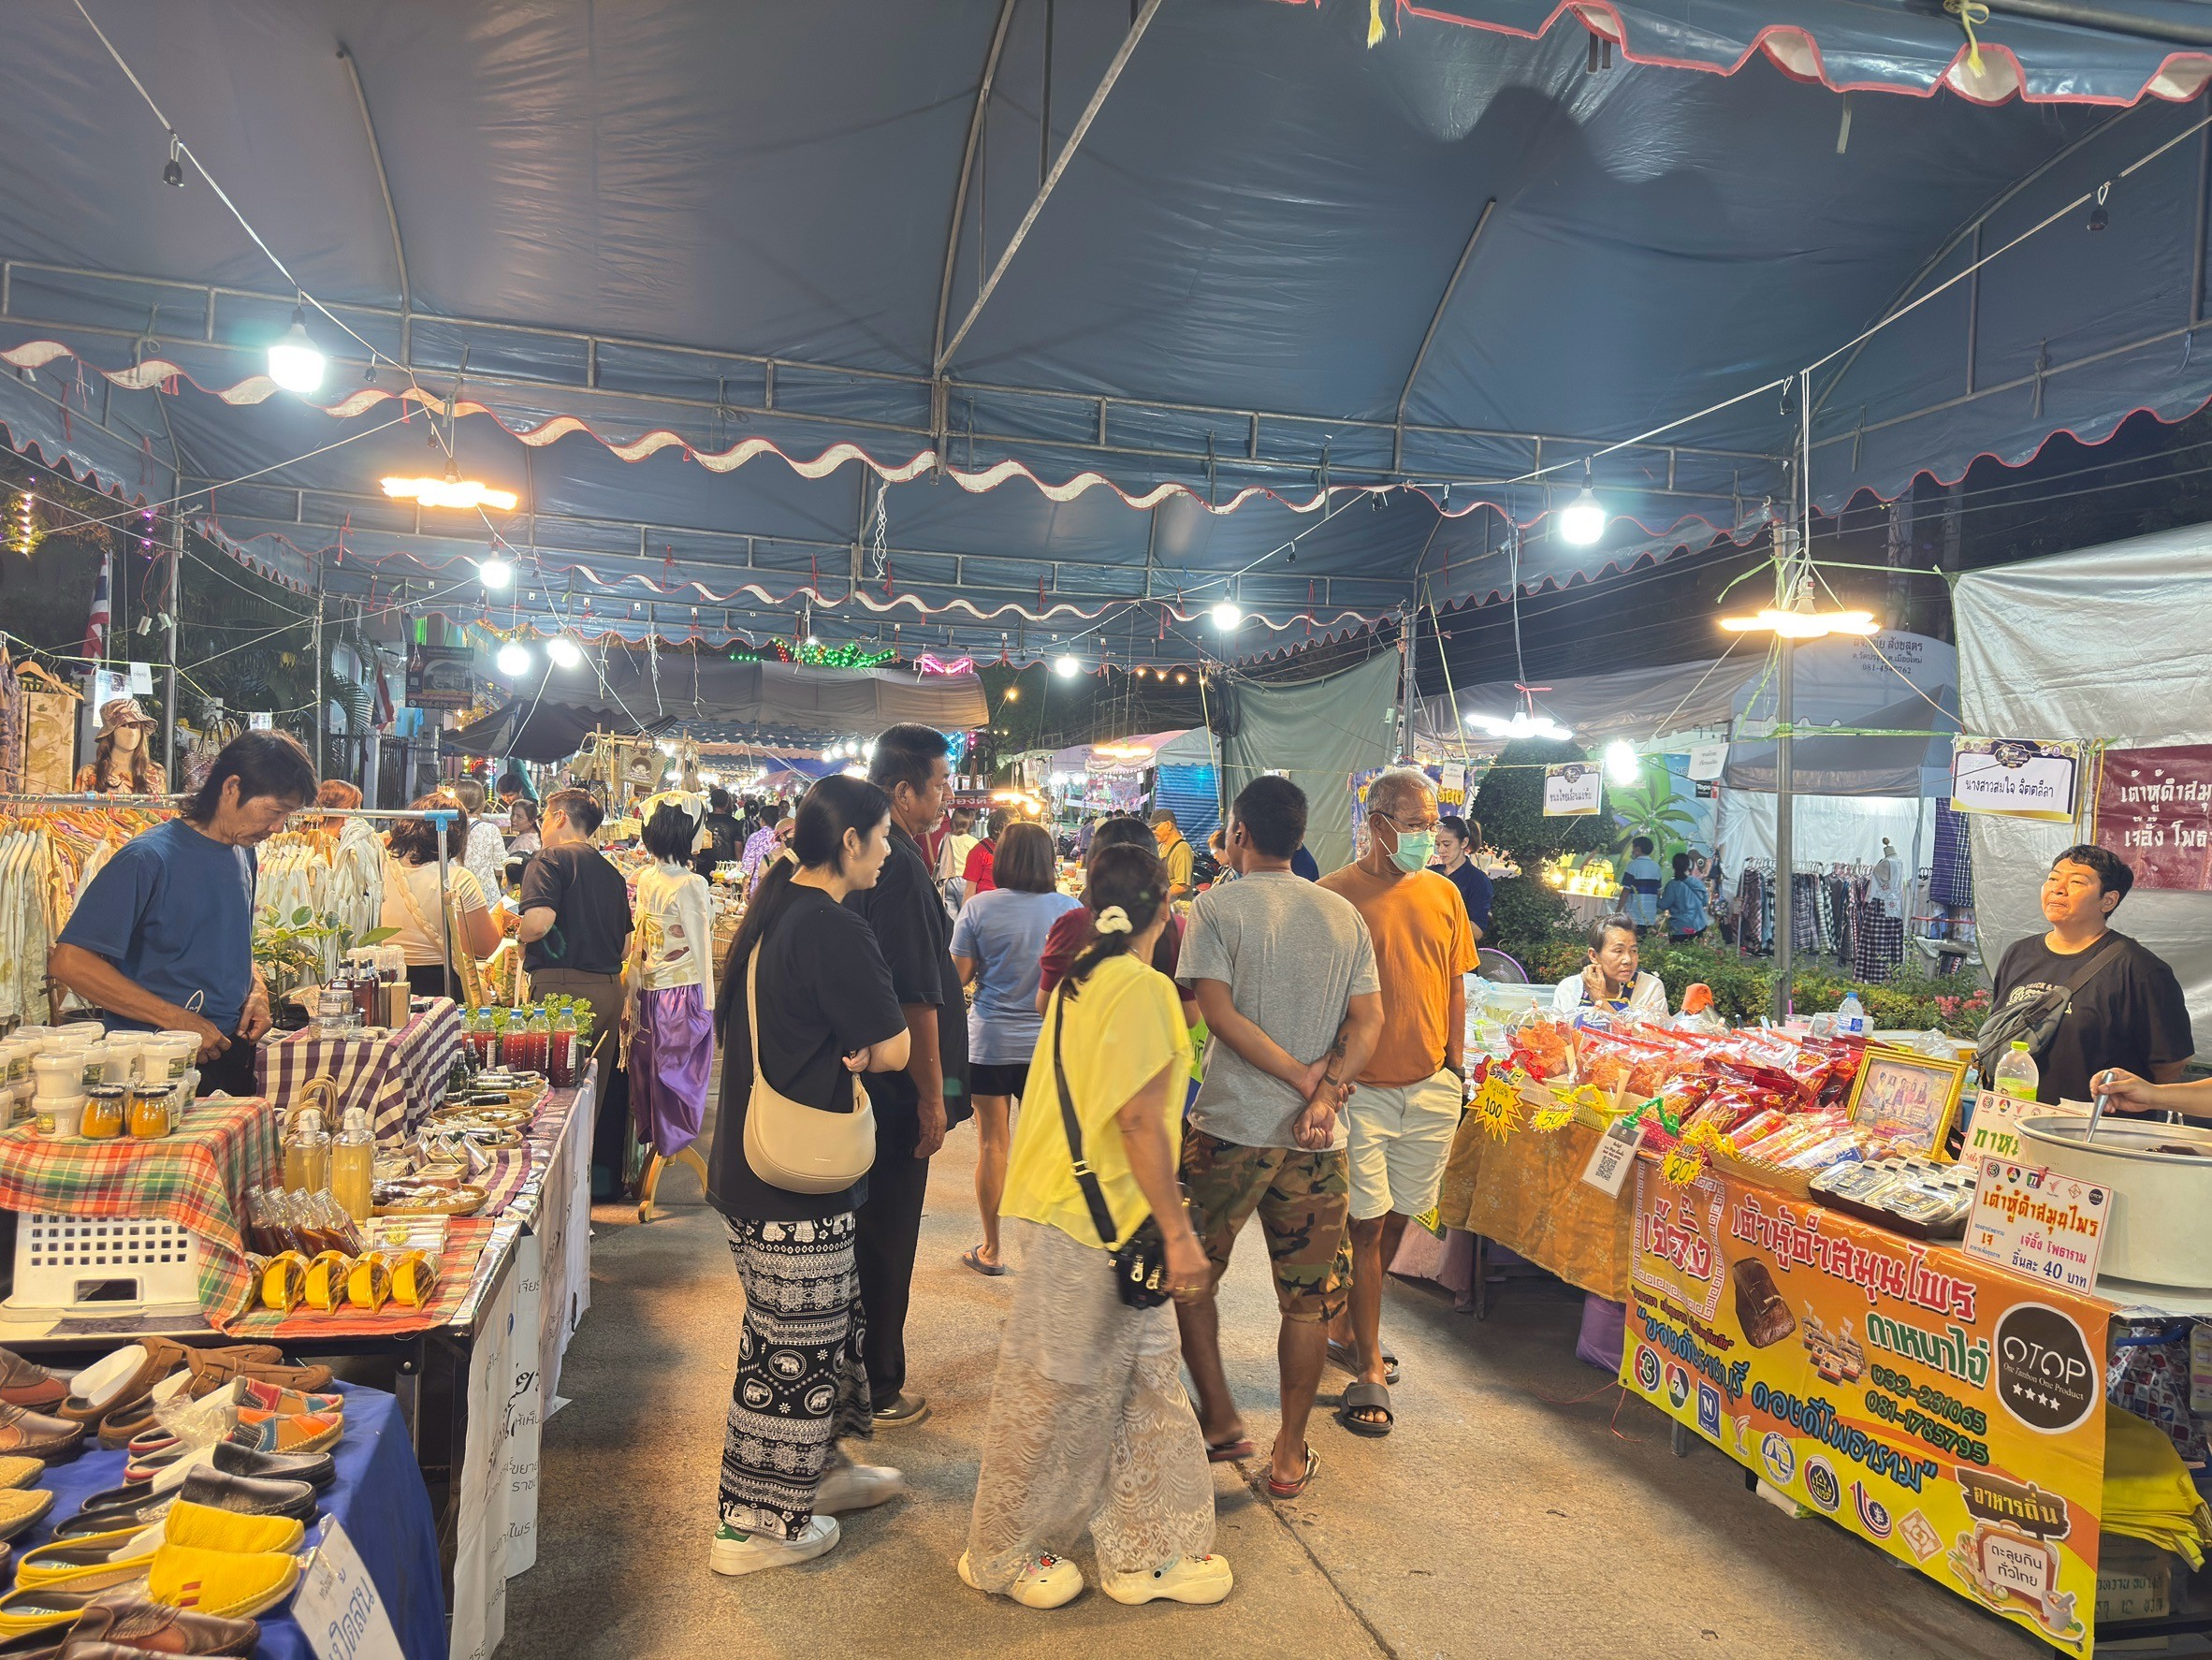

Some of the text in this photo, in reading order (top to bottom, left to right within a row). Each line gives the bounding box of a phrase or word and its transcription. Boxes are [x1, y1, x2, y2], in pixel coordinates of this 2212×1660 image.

[1966, 776, 2016, 794] นางสาวสมใจ
[2171, 820, 2212, 848] โพธ
[1484, 1097, 1503, 1119] 100
[1983, 1184, 2099, 1238] เต้าหู้ดำสมุนไพร
[1981, 1232, 1994, 1246] เจ
[2047, 1240, 2088, 1264] โพธาราม
[1731, 1193, 1978, 1325] เต้าหู้ดำสมุนไพร
[2012, 1247, 2088, 1288] ชิ้นละ 40 บาท
[2003, 1336, 2087, 1385] OTOP
[1870, 1363, 1987, 1436] 032-231065
[2003, 1361, 2084, 1401] One Tambon One Product
[1865, 1390, 1990, 1466] 081-1785795
[1973, 1486, 2059, 1525] อาหารถิ่น
[1991, 1545, 2043, 1570] ตะลุยกิน
[1998, 1562, 2038, 1587] ทั่วไทย
